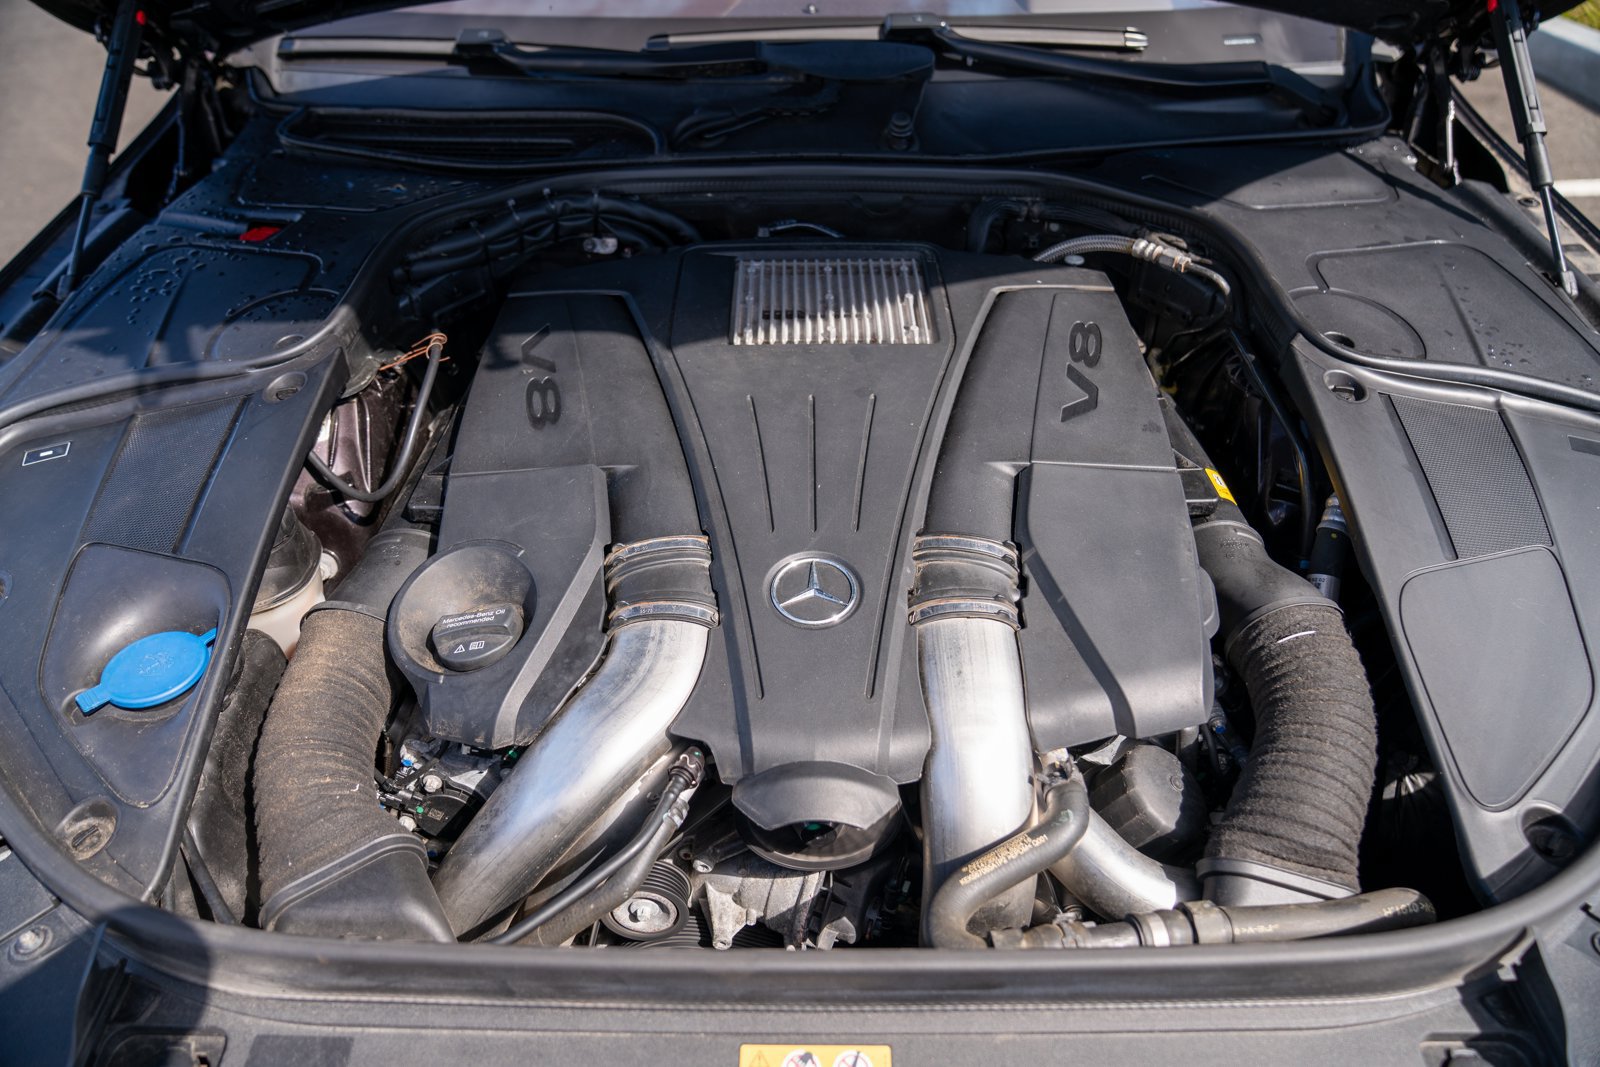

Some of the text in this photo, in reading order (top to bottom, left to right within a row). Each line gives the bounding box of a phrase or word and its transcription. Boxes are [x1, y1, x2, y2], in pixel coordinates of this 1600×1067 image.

[520, 323, 562, 431] V8
[1060, 320, 1103, 423] V8
[442, 611, 493, 624] Mercedes-Benz
[446, 615, 494, 628] recommended
